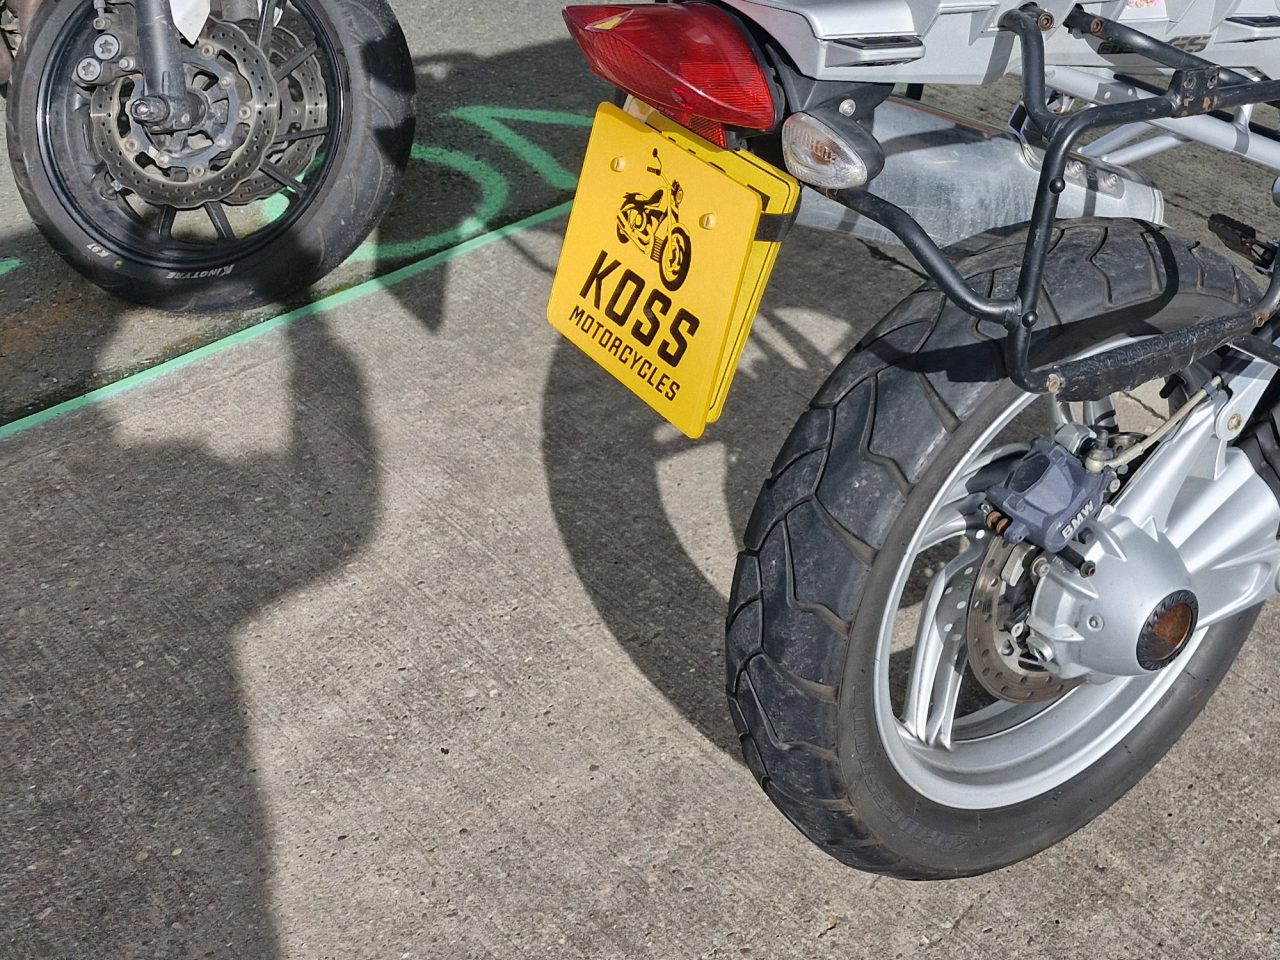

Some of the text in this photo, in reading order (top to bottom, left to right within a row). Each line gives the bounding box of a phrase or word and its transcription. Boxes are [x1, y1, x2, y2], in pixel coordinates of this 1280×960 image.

[568, 304, 681, 402] MOTORCYCLES
[579, 249, 701, 368] KOSS
[1061, 499, 1094, 539] BMW
